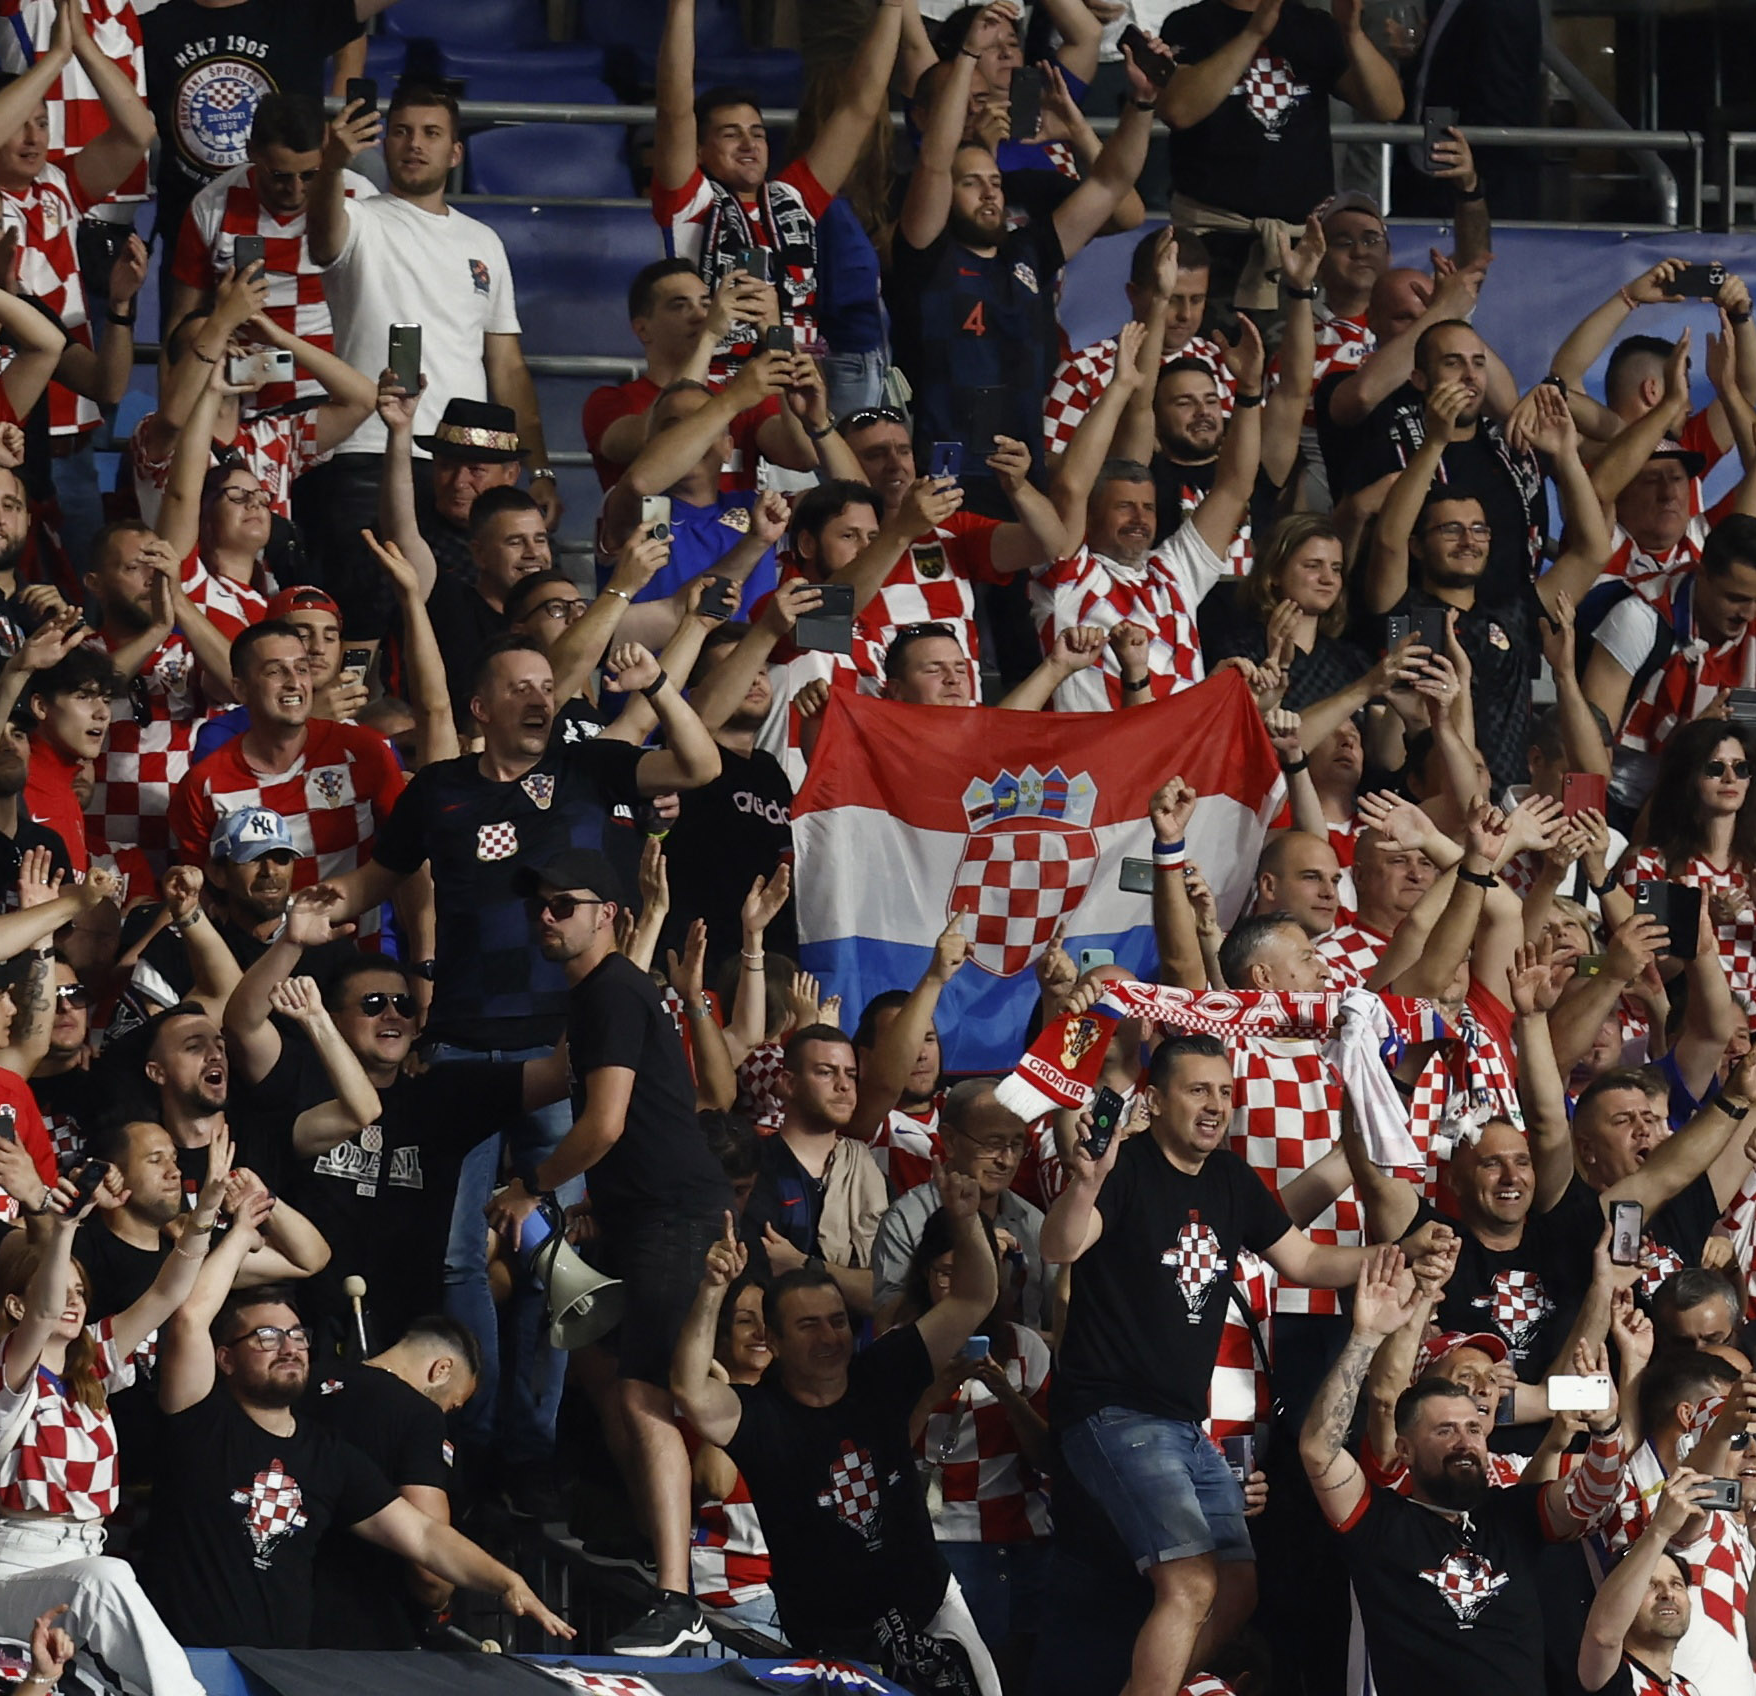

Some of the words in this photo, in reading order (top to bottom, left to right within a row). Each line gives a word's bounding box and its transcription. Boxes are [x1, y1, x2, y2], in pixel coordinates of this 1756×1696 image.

[226, 34, 270, 59] 1905
[205, 151, 244, 163] MOST
[962, 301, 986, 337] 4
[1125, 979, 1343, 1029] CROATI
[1028, 1057, 1087, 1100] CROATIA
